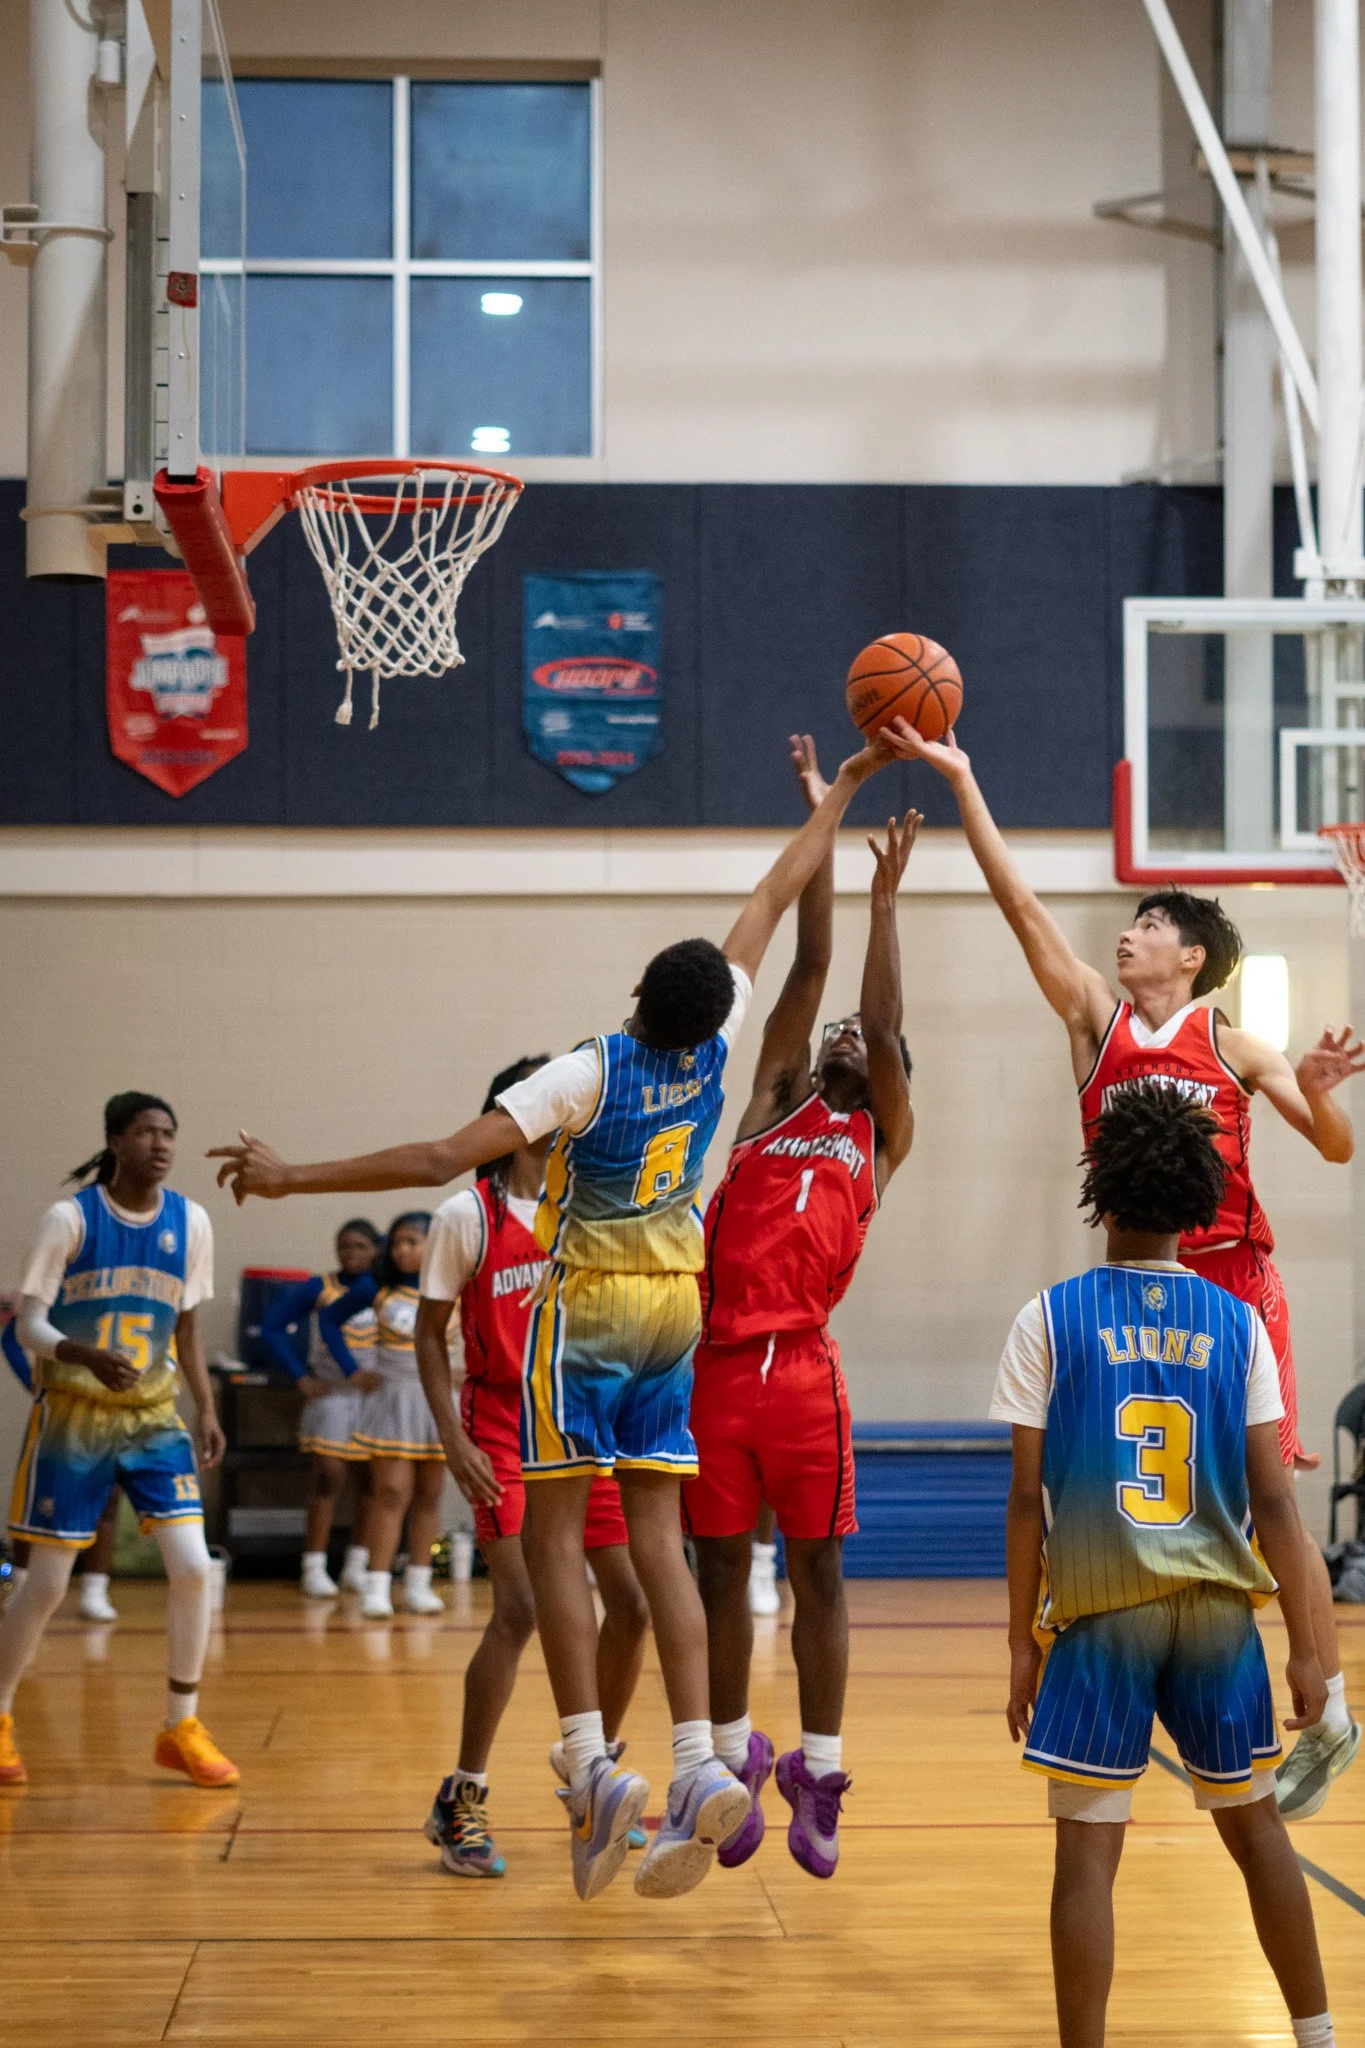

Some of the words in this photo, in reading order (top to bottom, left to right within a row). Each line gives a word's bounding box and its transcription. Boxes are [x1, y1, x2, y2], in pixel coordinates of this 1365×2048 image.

[1115, 1063, 1196, 1077] HARMONY
[631, 1120, 698, 1209] 8
[794, 1168, 815, 1214] 1
[95, 1311, 155, 1376] 15
[1099, 1325, 1215, 1370] LIONS
[1115, 1393, 1197, 1530] 3
[172, 1473, 200, 1501] 15
